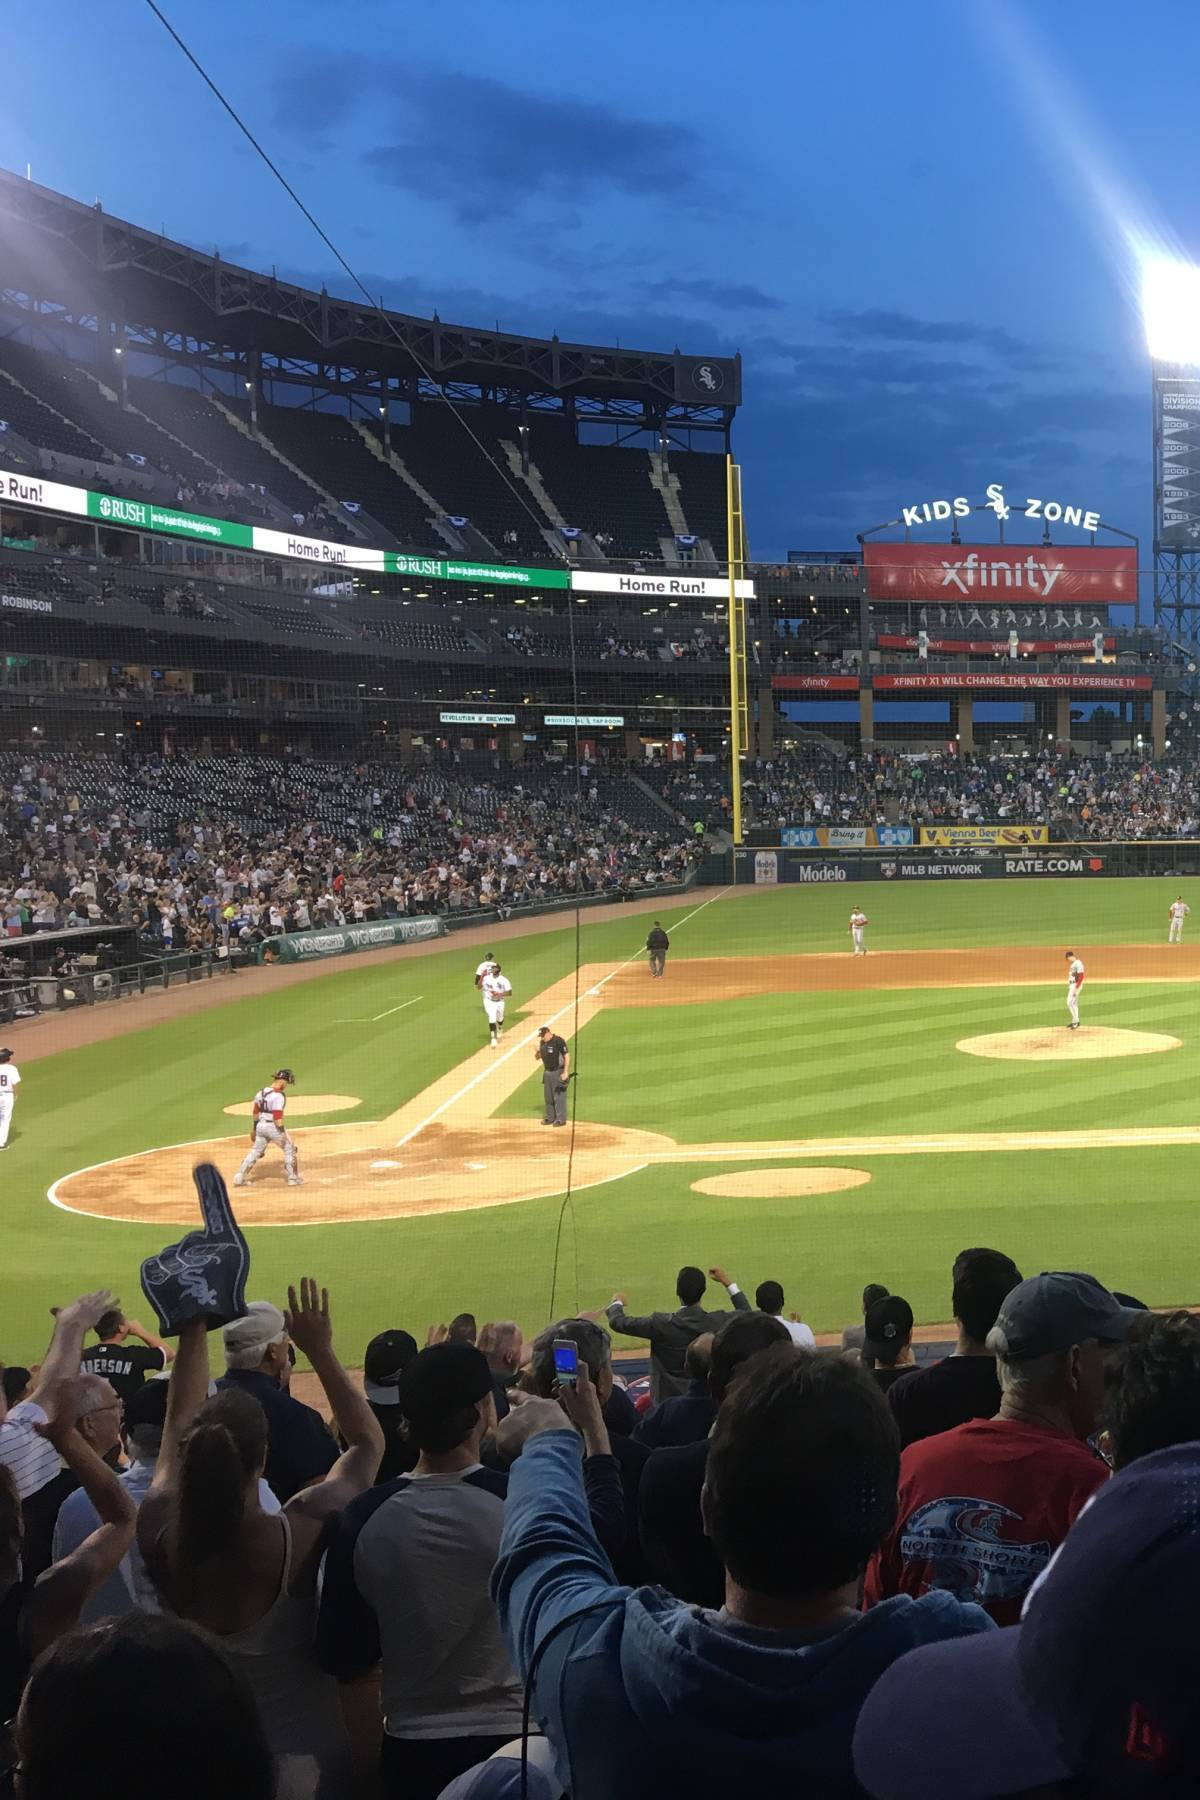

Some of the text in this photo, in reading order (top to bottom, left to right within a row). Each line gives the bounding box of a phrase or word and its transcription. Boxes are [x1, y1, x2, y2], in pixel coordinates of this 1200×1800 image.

[1163, 397, 1200, 405] DIVISION
[9, 478, 43, 502] Run!
[111, 500, 146, 523] RUSH
[902, 497, 970, 526] KIDS
[1024, 498, 1100, 532] ZONE
[288, 538, 346, 563] Home Run!
[409, 558, 442, 575] RUSH
[941, 553, 1064, 595] xfinity
[619, 578, 706, 594] Home Run!
[2, 595, 52, 612] ROBINSON
[801, 677, 830, 689] xfinity
[893, 676, 1136, 688] XFINITY X1 WILL CHANGE THE WAY YOU EXPERIENCE TV
[830, 828, 864, 841] Bring it
[942, 826, 976, 837] Vienna
[979, 826, 1000, 837] Beef
[800, 865, 846, 881] Modelo
[901, 864, 982, 875] MLB NETWORK
[1005, 859, 1083, 873] RATE.COM
[902, 1539, 1046, 1569] NORTH SHORE
